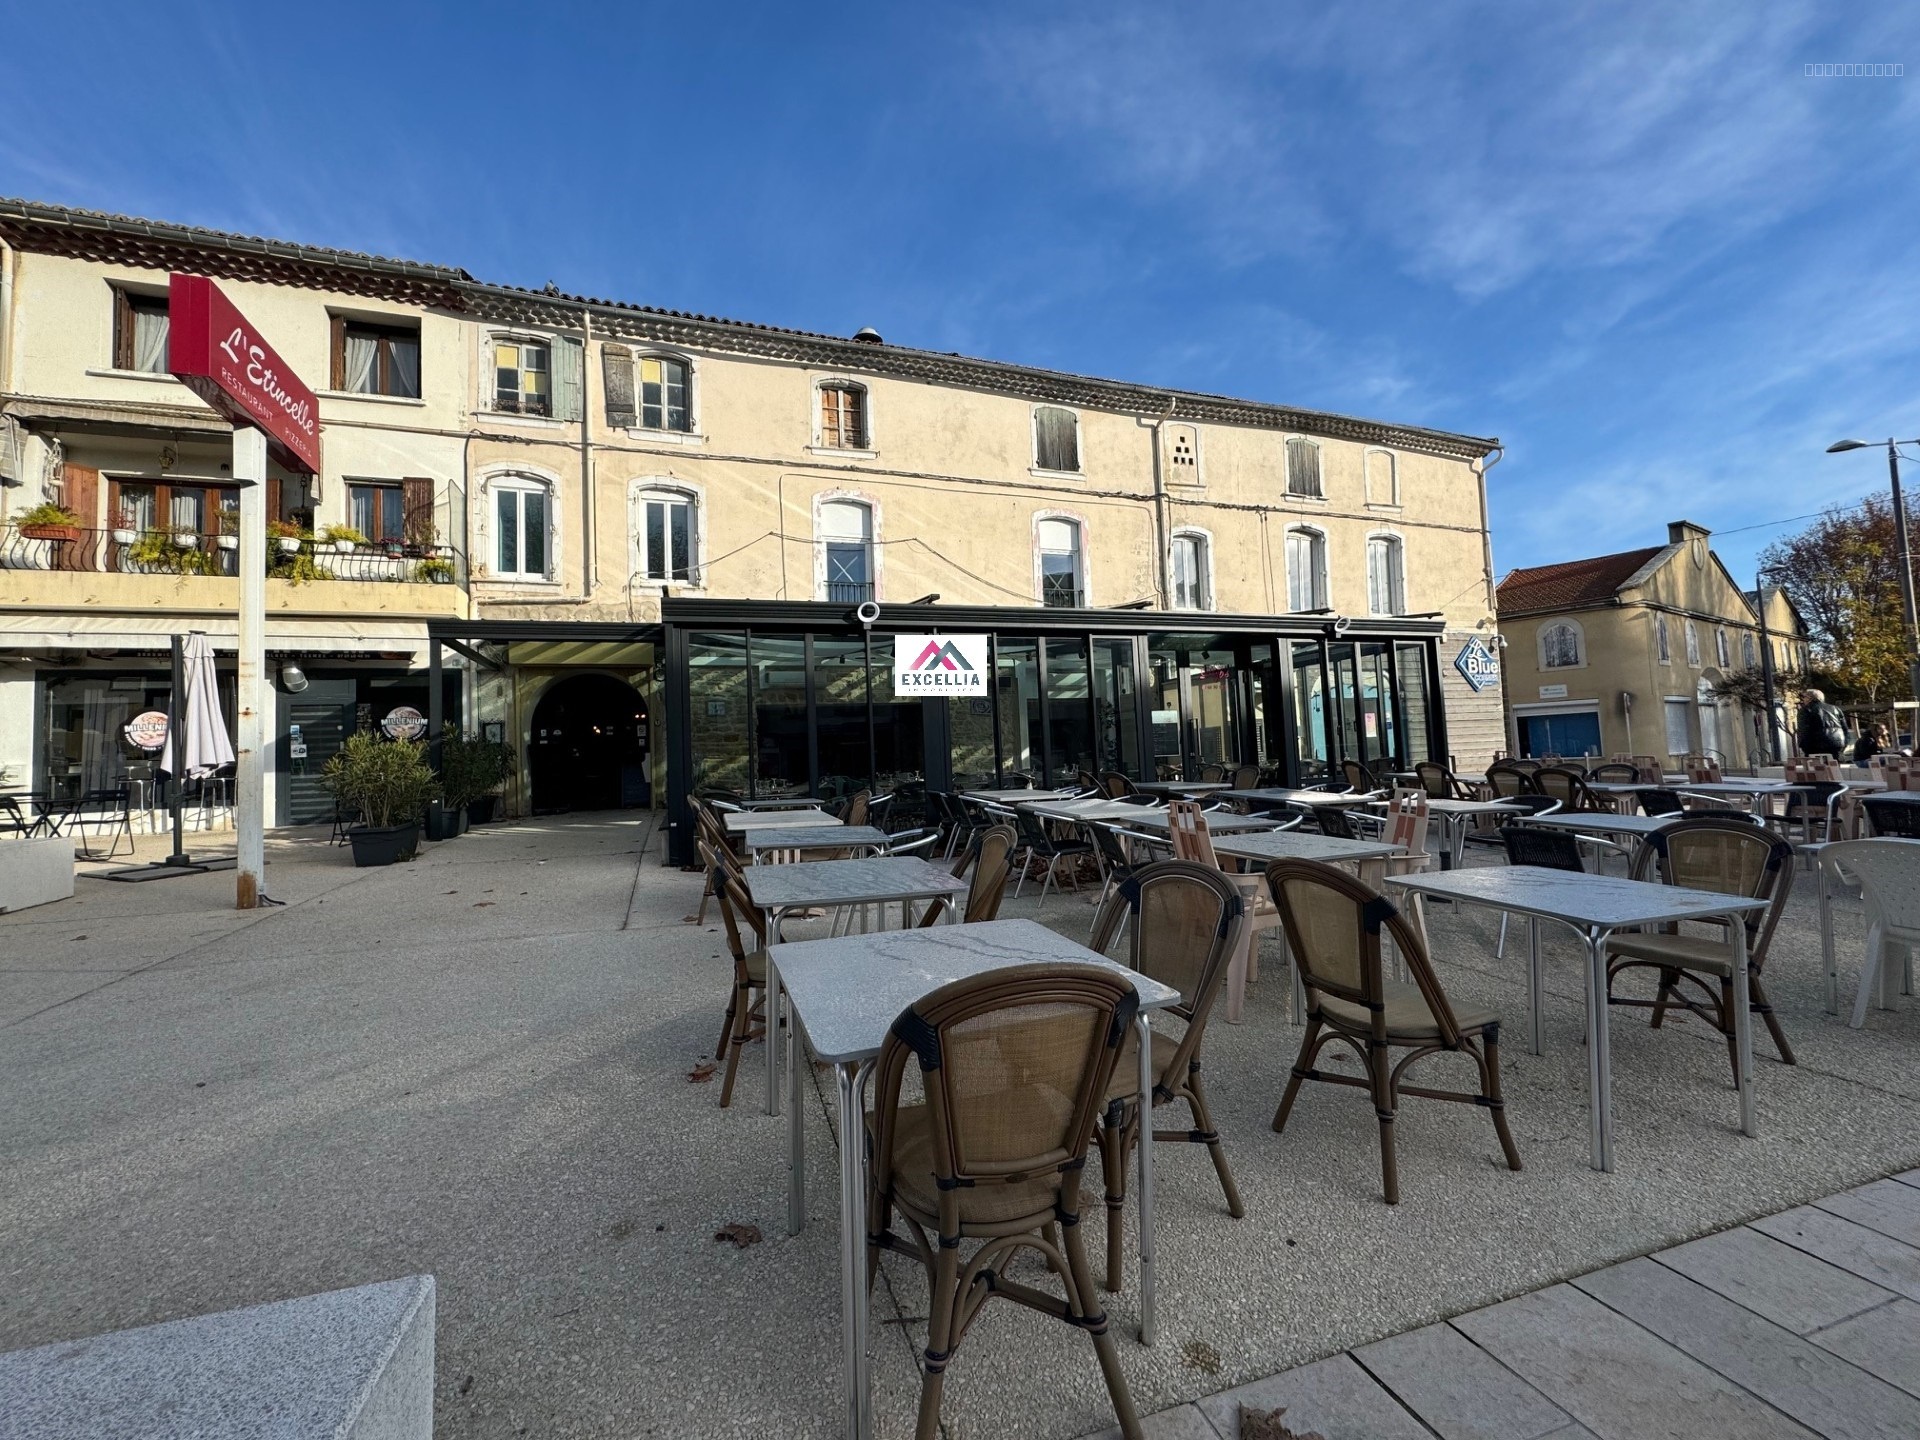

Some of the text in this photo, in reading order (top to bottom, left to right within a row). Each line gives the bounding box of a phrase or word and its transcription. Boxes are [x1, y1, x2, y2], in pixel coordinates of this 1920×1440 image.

[220, 327, 314, 436] L'Etincelle
[221, 366, 274, 422] RESTAURANT
[1467, 657, 1499, 674] Blue
[124, 723, 166, 733] MILLENI
[380, 717, 429, 726] MILLENIUM
